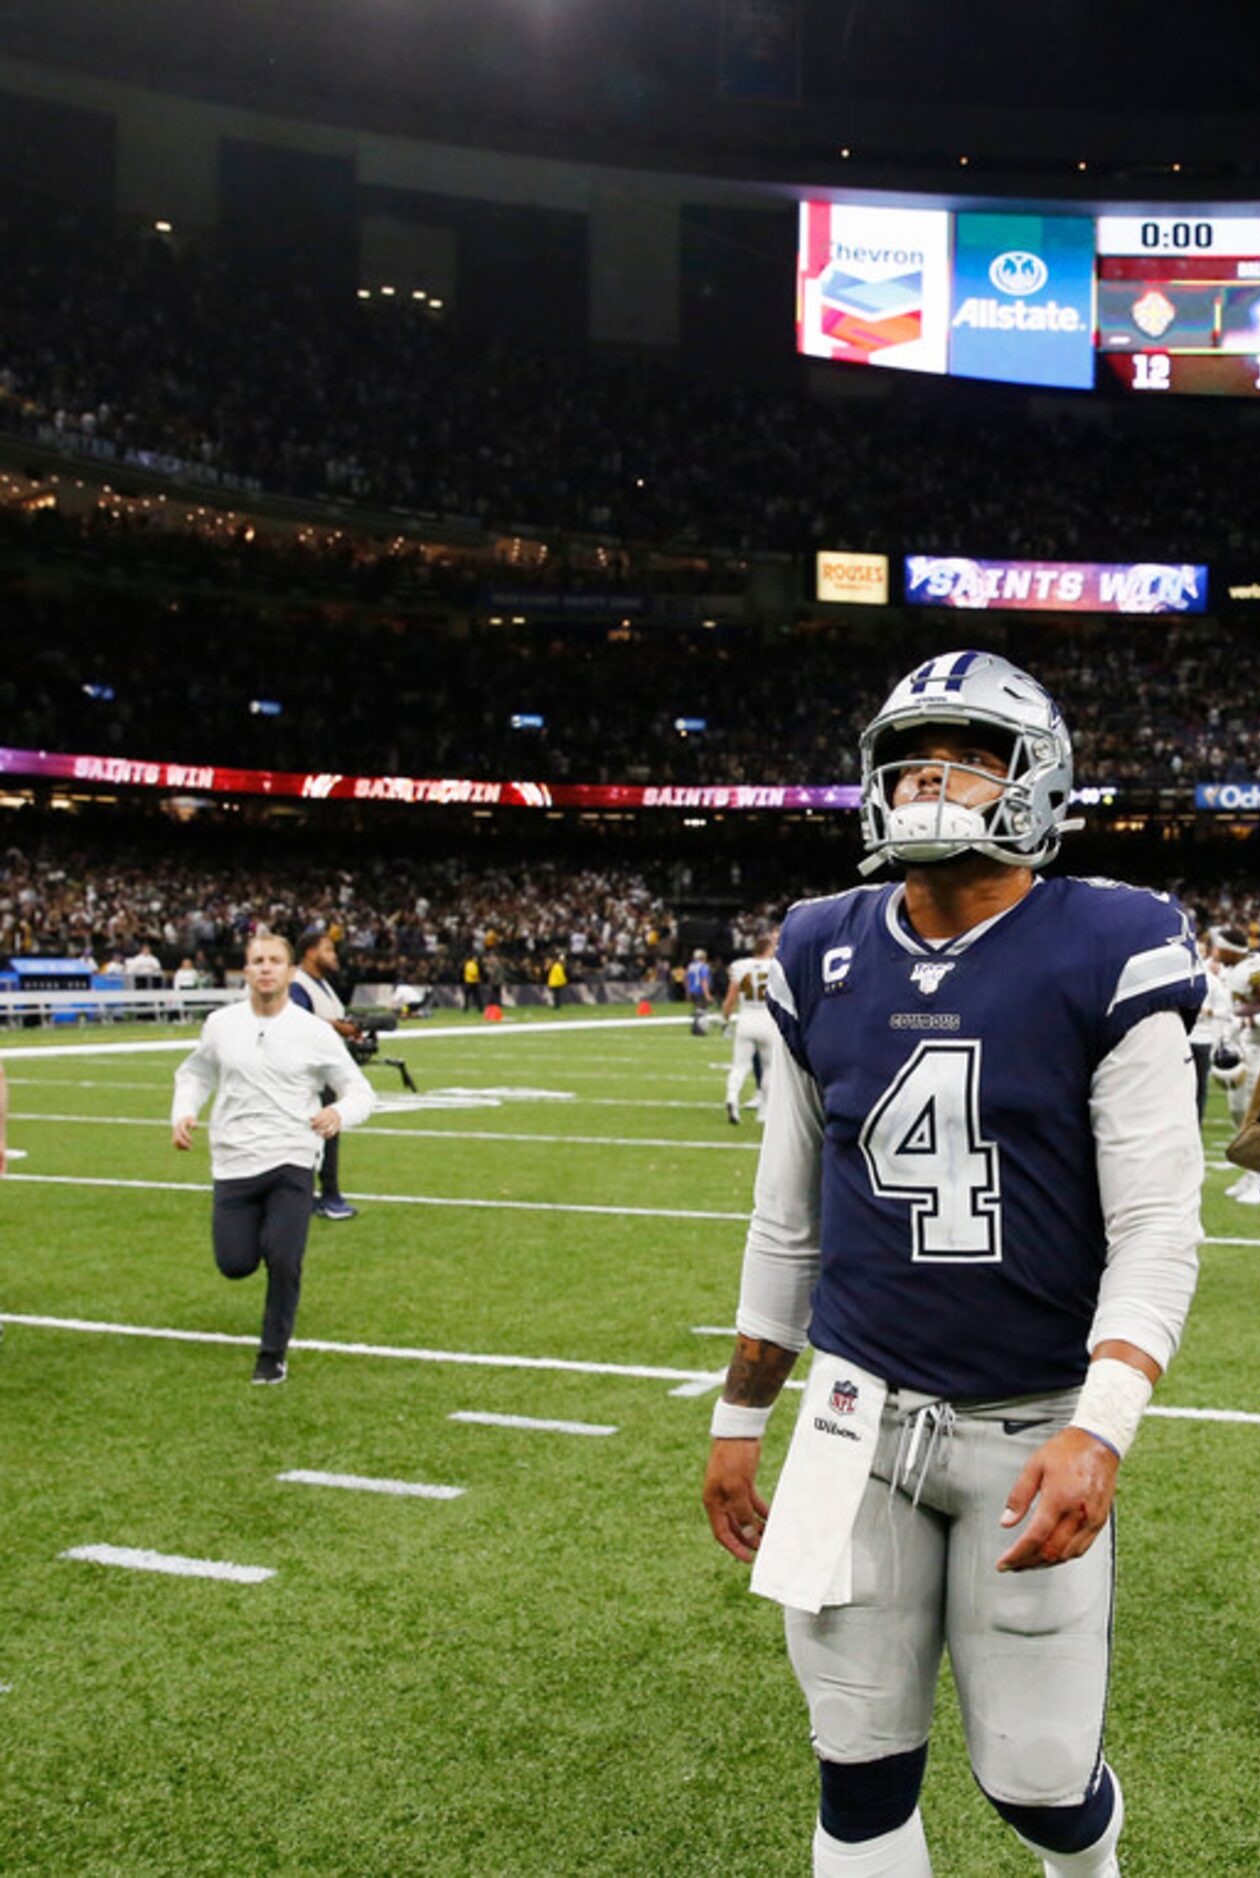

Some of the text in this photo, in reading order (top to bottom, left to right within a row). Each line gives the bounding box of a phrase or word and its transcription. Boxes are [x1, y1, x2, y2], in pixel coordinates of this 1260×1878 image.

[1141, 222, 1213, 248] 0:00
[1131, 354, 1170, 390] 12
[822, 563, 882, 583] ROUSES
[926, 567, 1083, 601] SAINTS
[74, 756, 214, 789] SAINTS WIN
[642, 786, 786, 808] SAINTS WIN
[822, 946, 853, 983] C
[859, 1038, 1003, 1263] 4
[813, 1417, 861, 1443] Wilson
